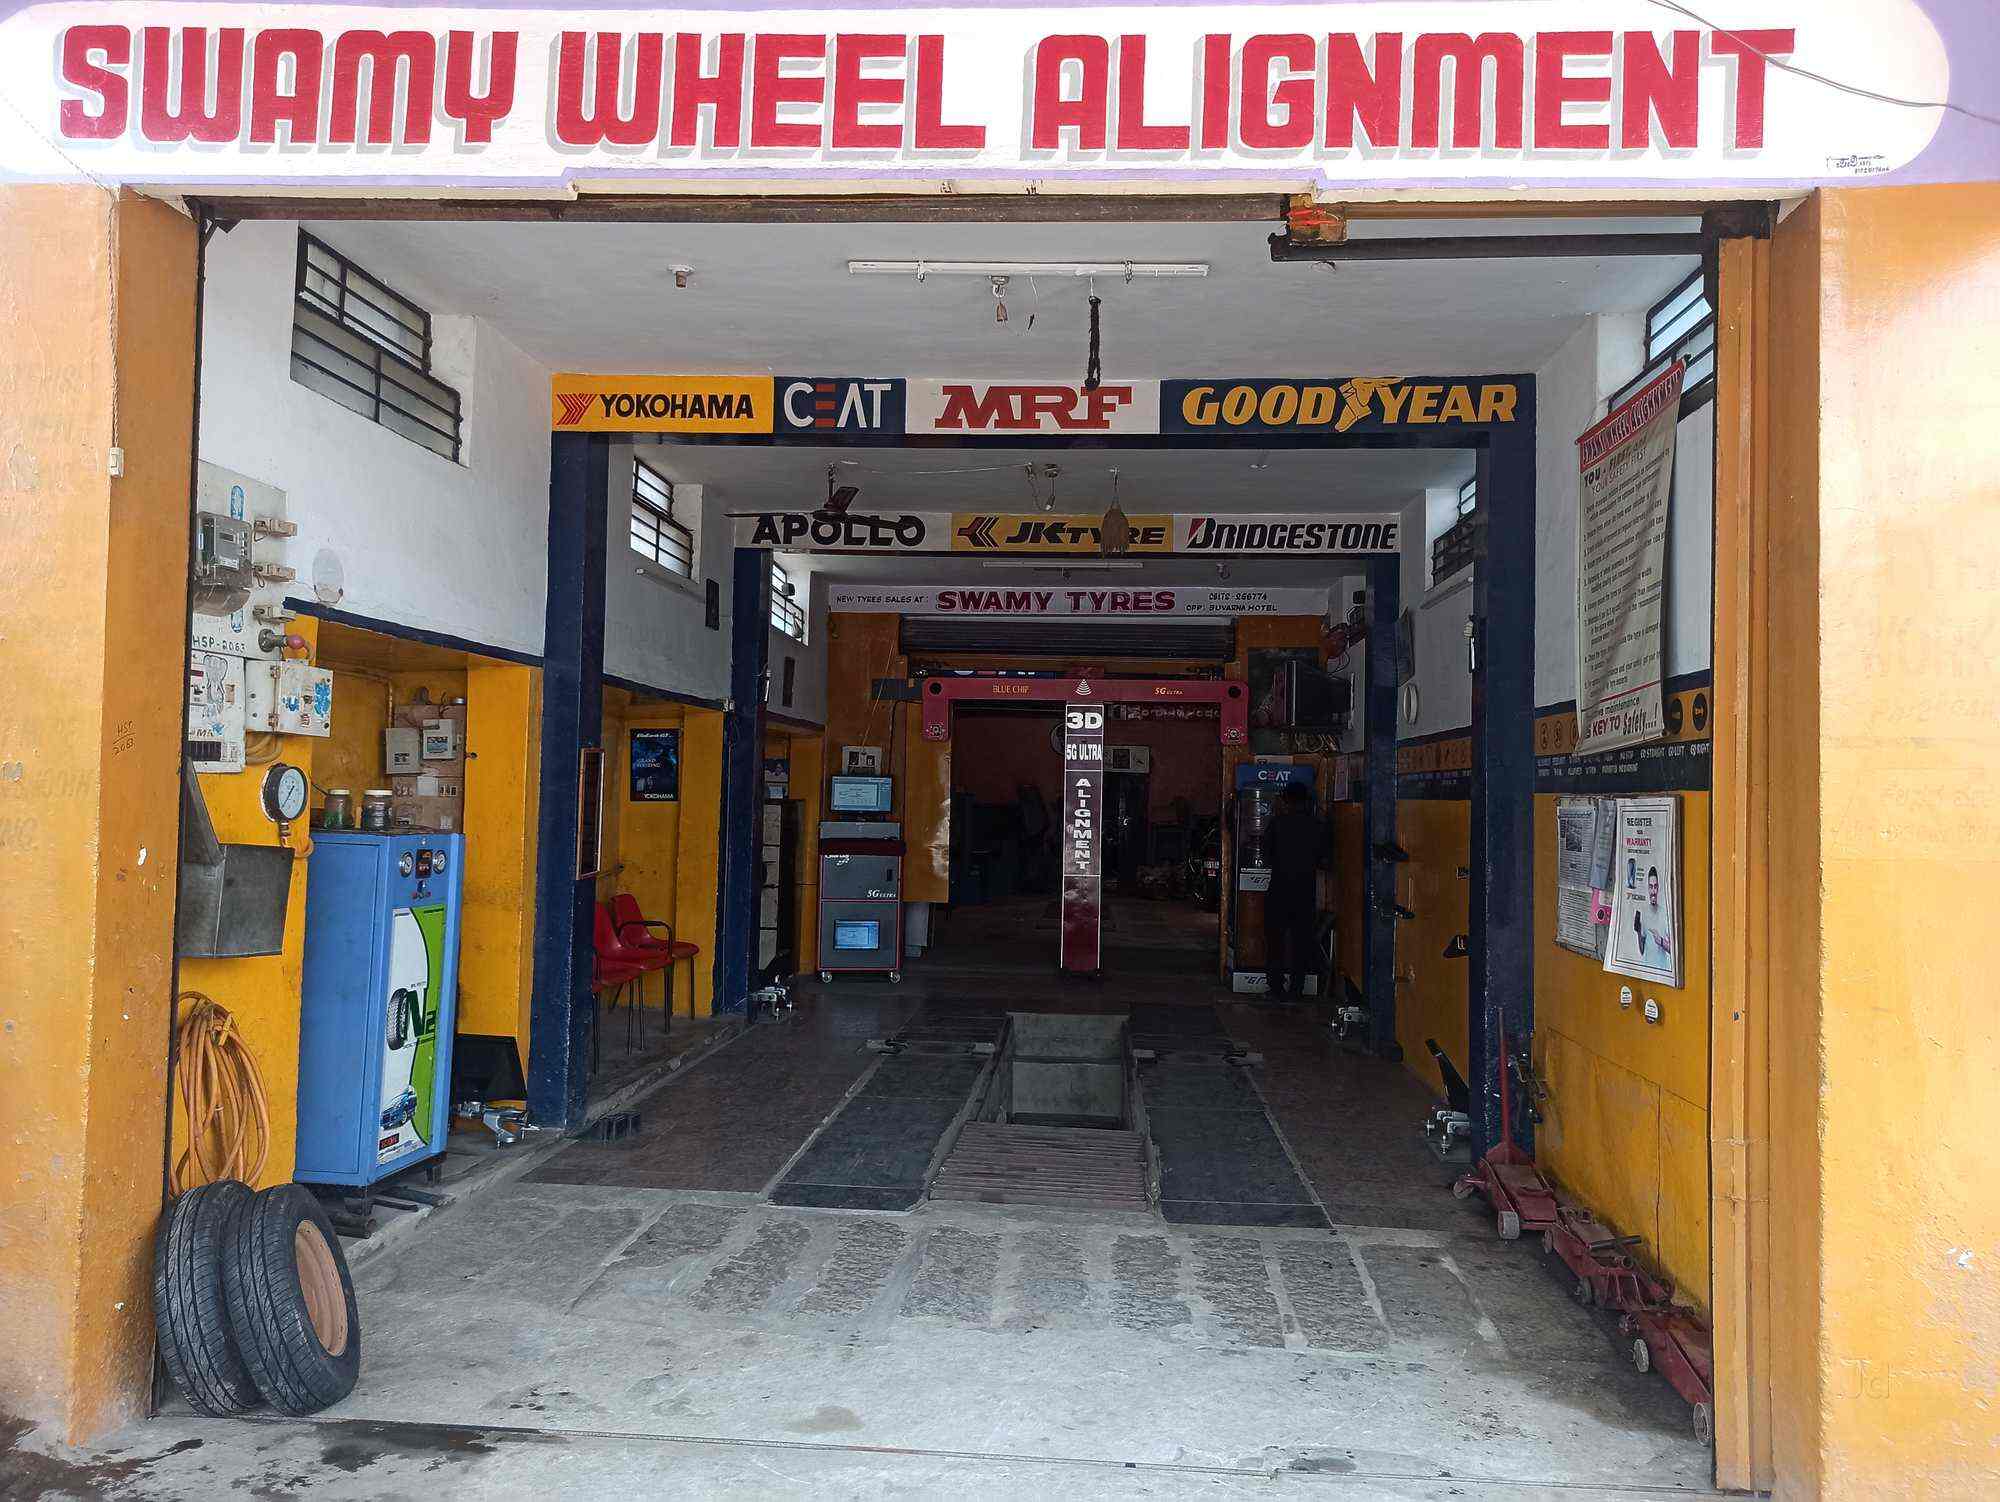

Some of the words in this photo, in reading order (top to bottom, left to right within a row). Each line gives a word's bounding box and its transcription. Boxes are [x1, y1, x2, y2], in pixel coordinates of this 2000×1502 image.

[60, 25, 518, 144] SWAMY
[556, 32, 986, 149] WHEEL
[1031, 28, 1796, 151] ALIGNMENT
[600, 393, 754, 421] YOKOHAMA
[783, 382, 892, 428] CEAT
[934, 385, 1132, 429] MRF
[751, 513, 926, 547] APOLLO
[1186, 517, 1398, 550] BRIDGESTONE
[836, 595, 854, 604] NEW
[885, 595, 912, 604] SALES
[936, 591, 1054, 613] SWAMY
[1065, 590, 1176, 613] TYRES
[992, 684, 1010, 694] BLUE
[1012, 684, 1030, 694] CHIP
[1066, 712, 1103, 730] 3D
[1591, 718, 1608, 737] KEY
[1609, 714, 1621, 731] TO
[1066, 743, 1077, 761] 5G
[1079, 743, 1102, 761] ULTRA
[1073, 778, 1092, 870] ALIGNMENT
[1626, 817, 1652, 827] REGISTER
